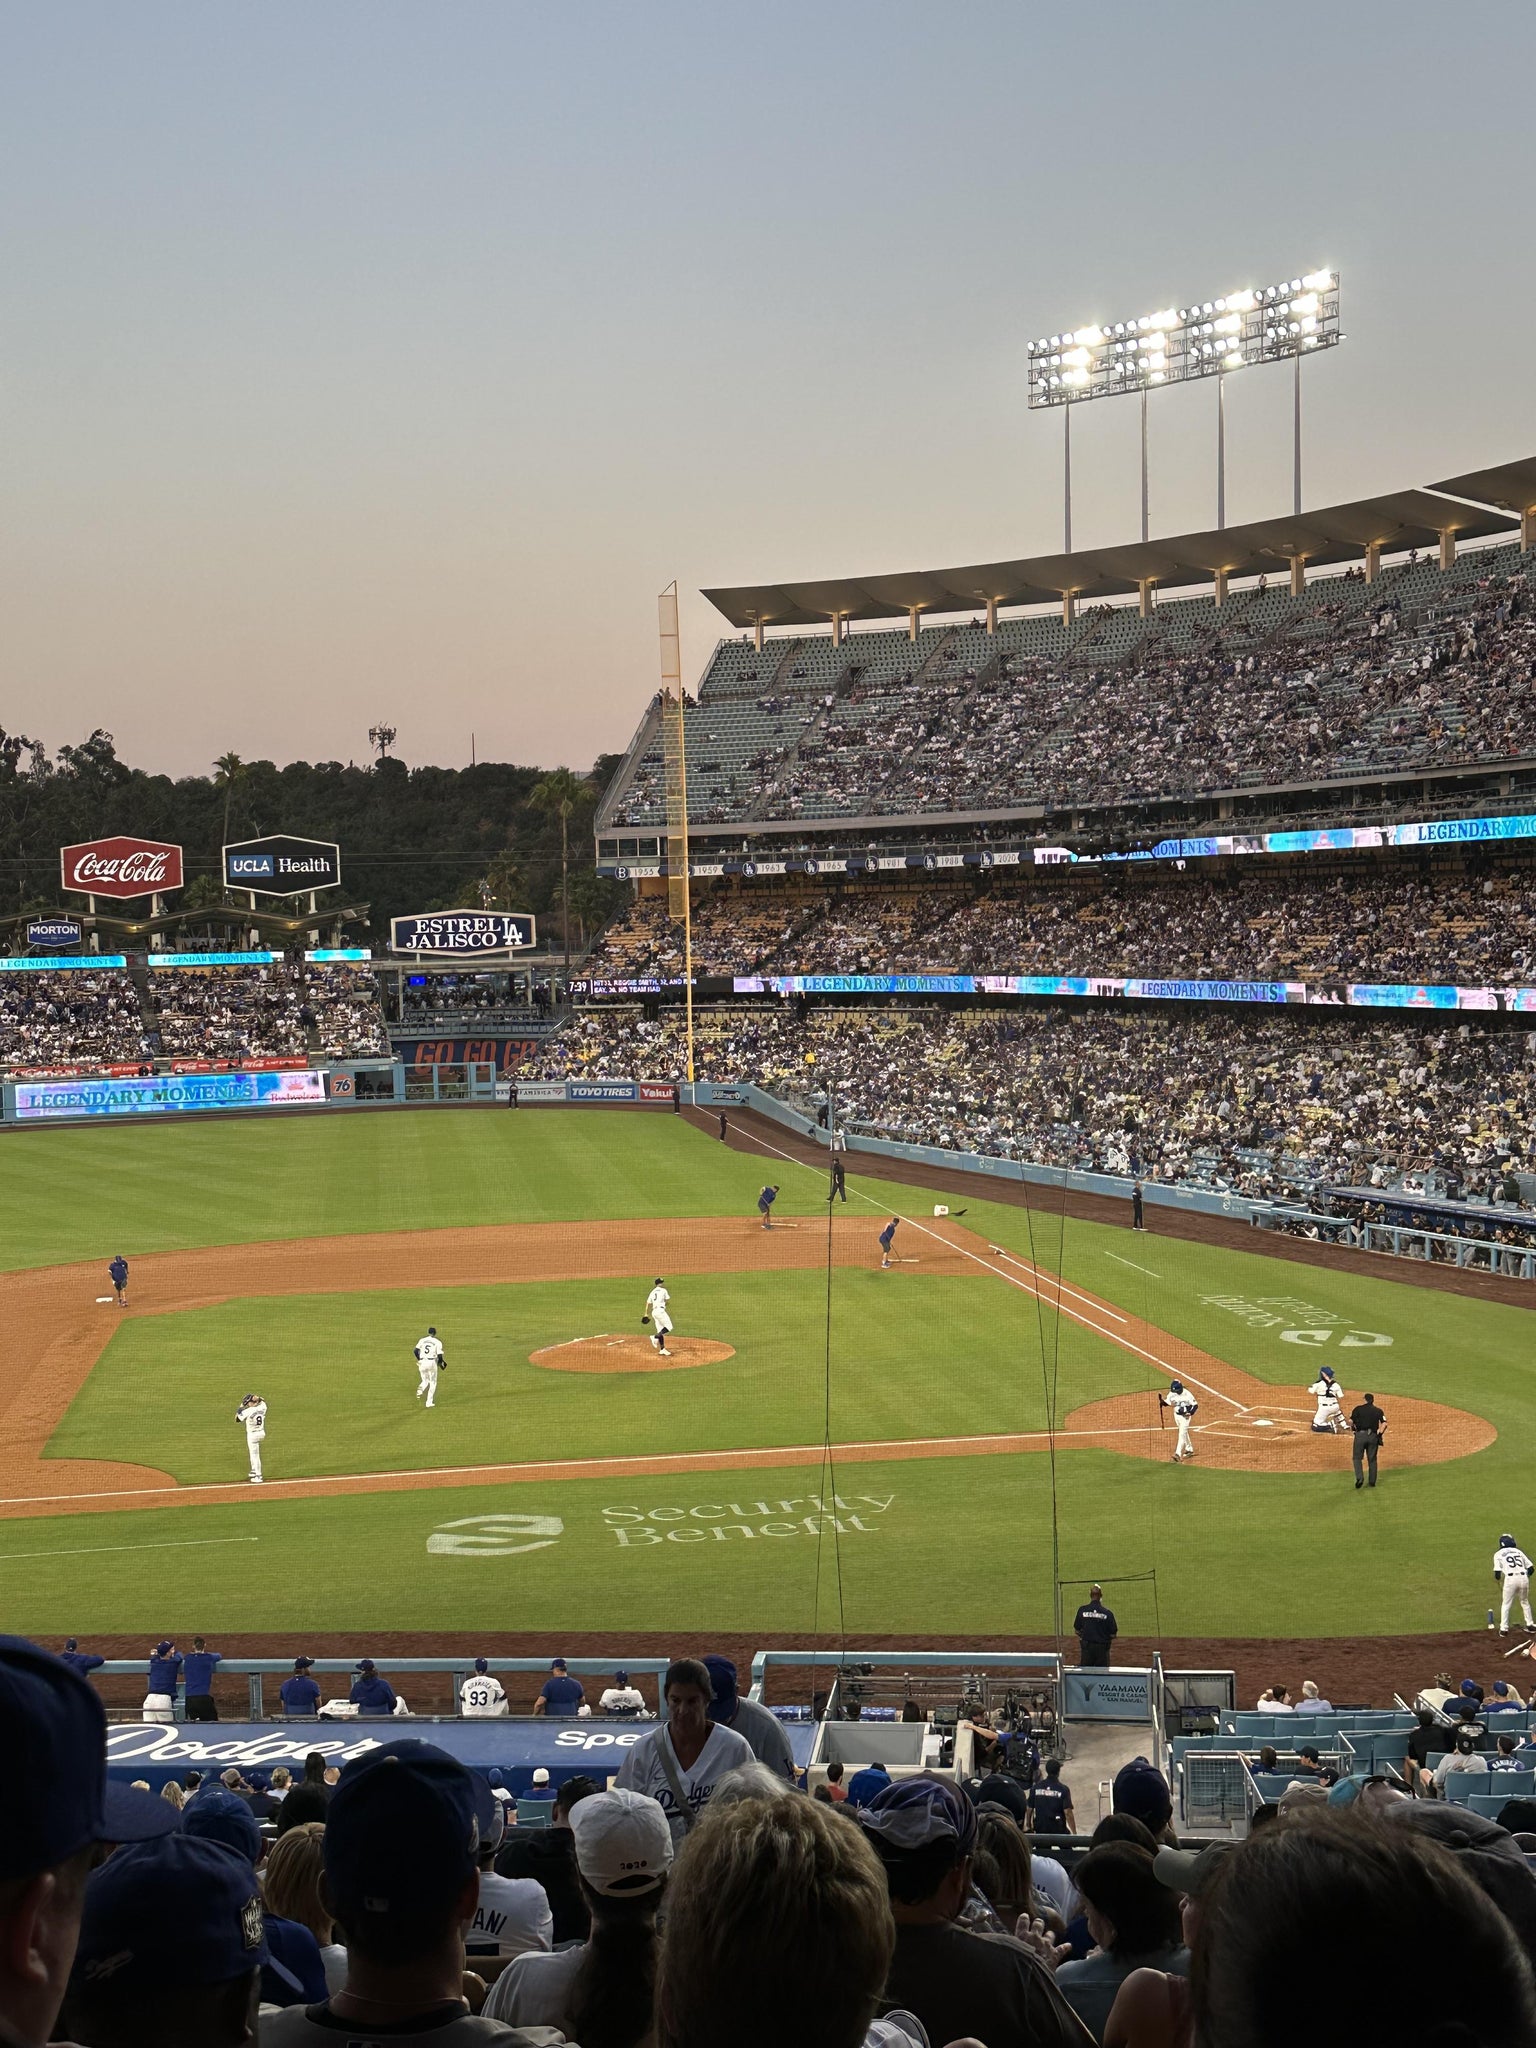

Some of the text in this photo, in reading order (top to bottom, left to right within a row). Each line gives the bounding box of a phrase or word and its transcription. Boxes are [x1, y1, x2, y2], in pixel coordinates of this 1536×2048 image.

[1418, 821, 1516, 841] LEGENDARY
[73, 852, 171, 883] Coca-Cola
[233, 857, 331, 873] UCLA Health
[822, 861, 842, 870] 1965
[998, 855, 1016, 864] 2020
[29, 925, 79, 935] MORTON
[405, 932, 498, 949] JALISCO
[569, 981, 587, 992] 7:39
[802, 977, 961, 991] LEGENDARY MOMENTS
[1141, 982, 1278, 1001] LEGENDARY MOMENTS
[414, 1041, 455, 1075] GO
[334, 1079, 351, 1092] 76
[572, 1087, 633, 1097] TOYO TIRES
[30, 1083, 255, 1108] LEGENDARY MOMENTS
[424, 1345, 431, 1354] 5
[601, 1494, 896, 1525] Security
[609, 1514, 881, 1548] Benefit
[1506, 1555, 1523, 1568] 95
[470, 1690, 488, 1706] 93
[106, 1723, 385, 1767] Dodger
[620, 1860, 648, 1870] 2020
